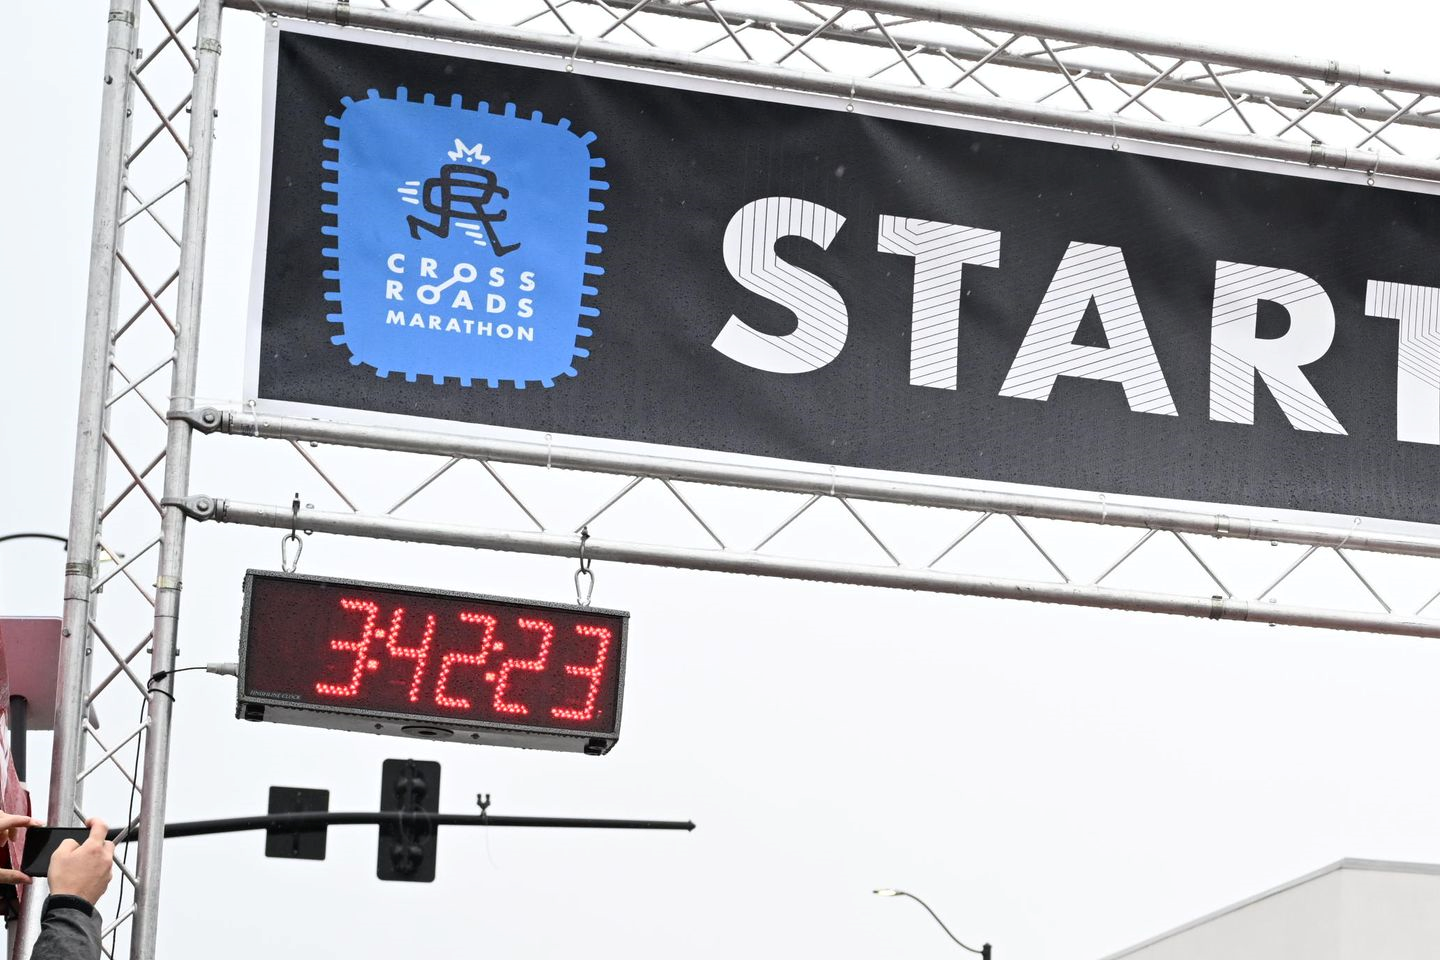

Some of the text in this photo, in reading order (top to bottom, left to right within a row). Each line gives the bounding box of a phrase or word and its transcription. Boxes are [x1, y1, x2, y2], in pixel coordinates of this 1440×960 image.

[387, 253, 536, 291] CROSS
[385, 280, 535, 318] ROADS
[385, 310, 535, 342] MARATHON
[315, 598, 612, 720] 3:42:23
